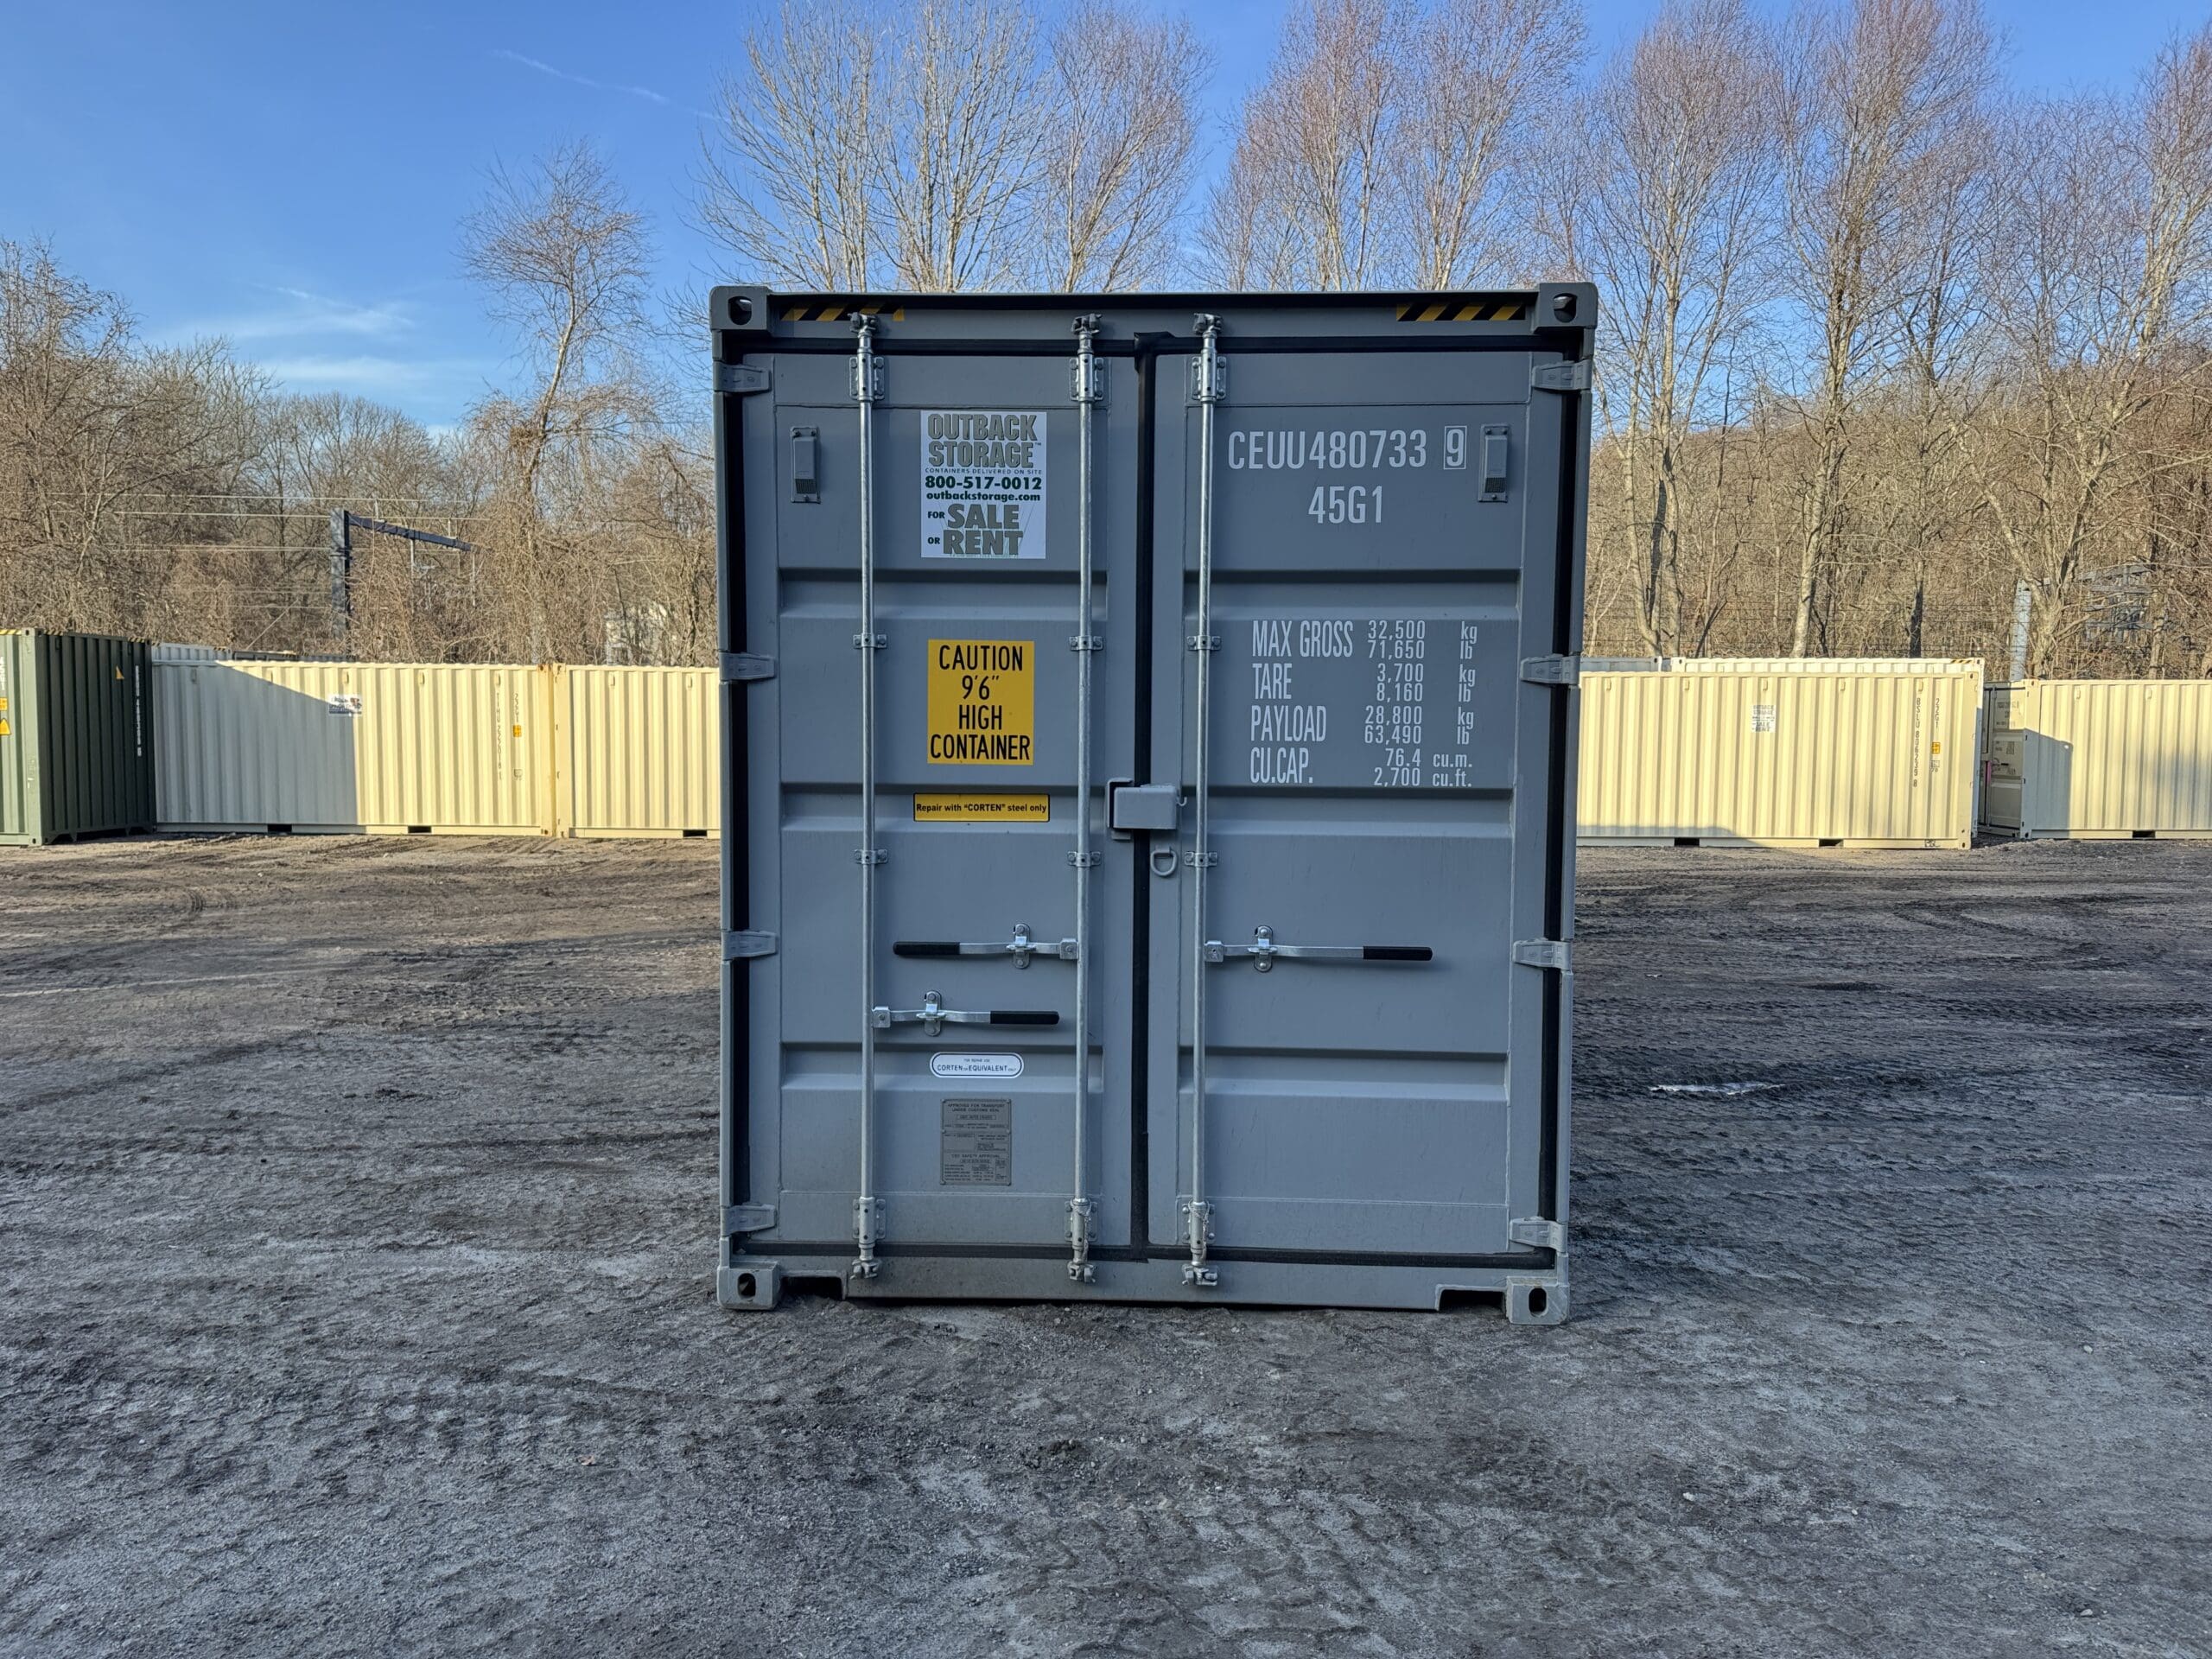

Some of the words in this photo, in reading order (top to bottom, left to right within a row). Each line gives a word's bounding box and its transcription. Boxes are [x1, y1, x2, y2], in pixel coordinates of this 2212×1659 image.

[927, 413, 1038, 442] OUTBACK
[928, 441, 1034, 468] STORAGE
[1228, 429, 1427, 469] CEUU480733
[1446, 429, 1465, 467] 9
[925, 475, 1042, 490] 800-517-0012
[926, 490, 1040, 503] outbackstorage.com
[1308, 486, 1382, 524] 45G1
[927, 511, 945, 519] FOR
[947, 503, 1020, 530] SALE
[927, 537, 940, 545] OR
[943, 529, 1024, 556] RENT
[1252, 620, 1293, 658] MAX
[1300, 620, 1354, 658] GROSS
[1367, 620, 1426, 639] 32,500
[1460, 620, 1478, 645] kg
[1367, 639, 1426, 660] 71,650
[1459, 640, 1473, 660] lb
[938, 645, 1023, 671] CAUTION
[1252, 663, 1293, 700] TARE
[1376, 663, 1424, 683] 3,700
[1459, 663, 1476, 687] kg
[1376, 683, 1424, 702] 8,160
[1458, 683, 1471, 702] lb
[958, 704, 1002, 730] HIGH
[1250, 705, 1327, 742] PAYLOAD
[1364, 705, 1422, 726] 28,800
[1457, 706, 1474, 730] kg
[930, 734, 1031, 760] CONTAINER
[1363, 724, 1422, 745] 63,490
[1456, 725, 1470, 745] lb
[1249, 747, 1314, 784] CU.CAP.
[1384, 747, 1422, 767] 76.4
[1432, 753, 1473, 768] cu.m.
[1373, 766, 1421, 787] 2,700
[1432, 769, 1472, 787] cu.ft.
[916, 804, 942, 812] Repair
[1029, 804, 1046, 813] only
